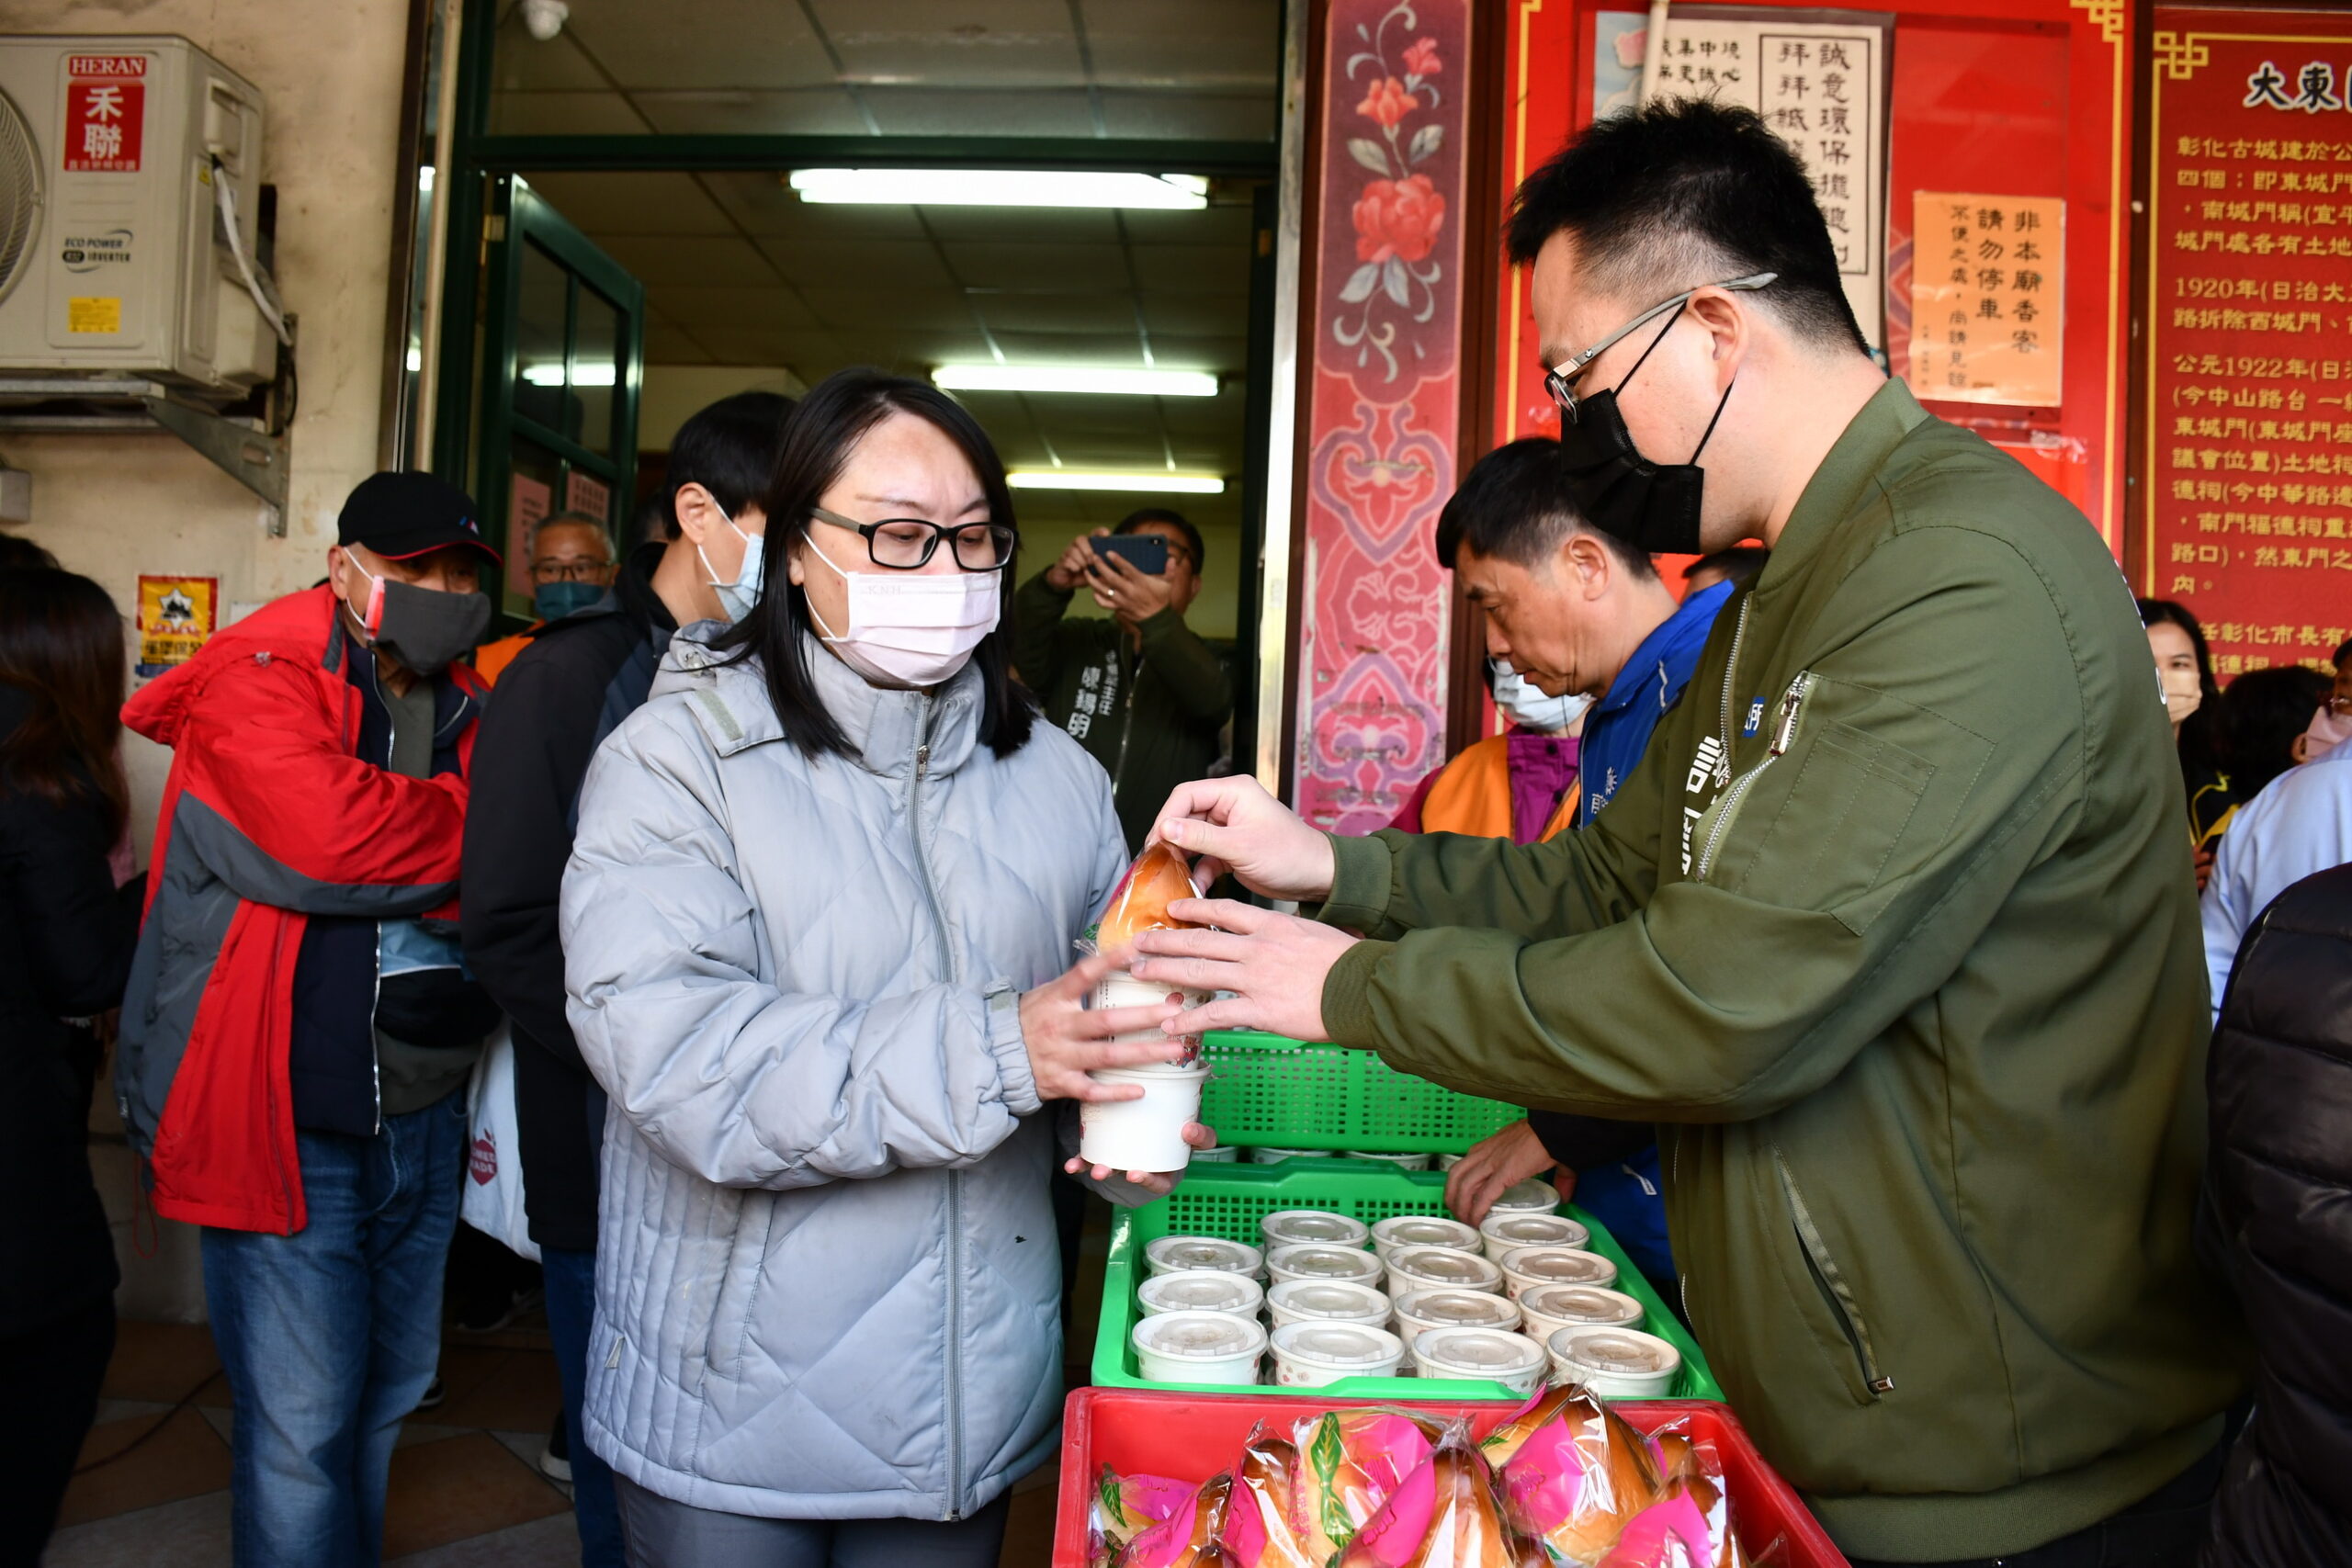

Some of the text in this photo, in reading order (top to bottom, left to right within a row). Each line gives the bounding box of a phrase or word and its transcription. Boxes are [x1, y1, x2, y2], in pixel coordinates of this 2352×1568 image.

[72, 58, 143, 74] HERAN
[1778, 42, 1811, 154] 拜拜紙
[2243, 61, 2352, 115] 大東
[84, 85, 124, 160] 禾聯
[88, 252, 130, 263] INVERTER
[1976, 207, 2005, 321] 請勿停車
[2013, 209, 2042, 354] 非本廟香客
[2175, 276, 2352, 304] 1920年(日治大
